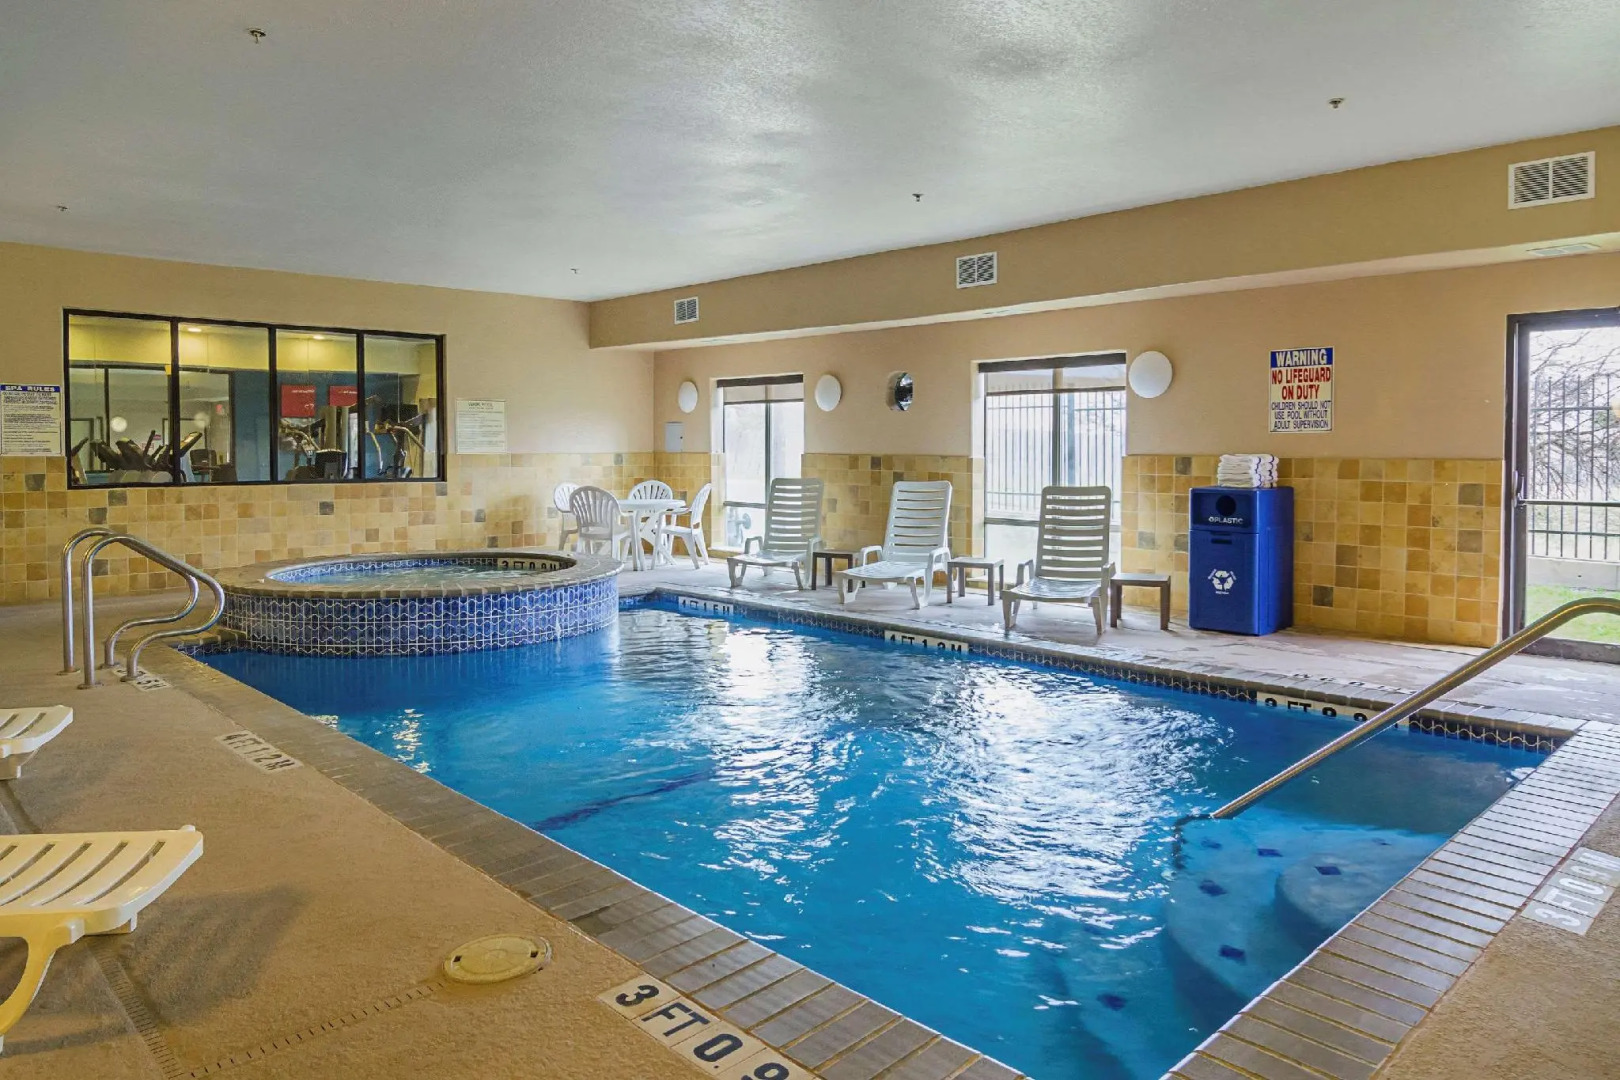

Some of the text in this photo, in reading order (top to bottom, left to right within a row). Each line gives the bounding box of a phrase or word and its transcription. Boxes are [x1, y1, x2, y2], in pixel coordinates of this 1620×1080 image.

[1276, 349, 1328, 367] WARNING
[1272, 367, 1331, 384] NO LIFEGUARD
[1282, 384, 1320, 400] ON DUTY
[1272, 400, 1332, 410] CHILDREN SHOULD NOT
[1275, 410, 1328, 420] USE POOL WITHOUT
[1274, 420, 1329, 429] ADULT SUPERVISION
[1543, 888, 1595, 915] FT
[1535, 908, 1581, 927] 3
[615, 984, 660, 1008] 3
[641, 1002, 711, 1038] FT
